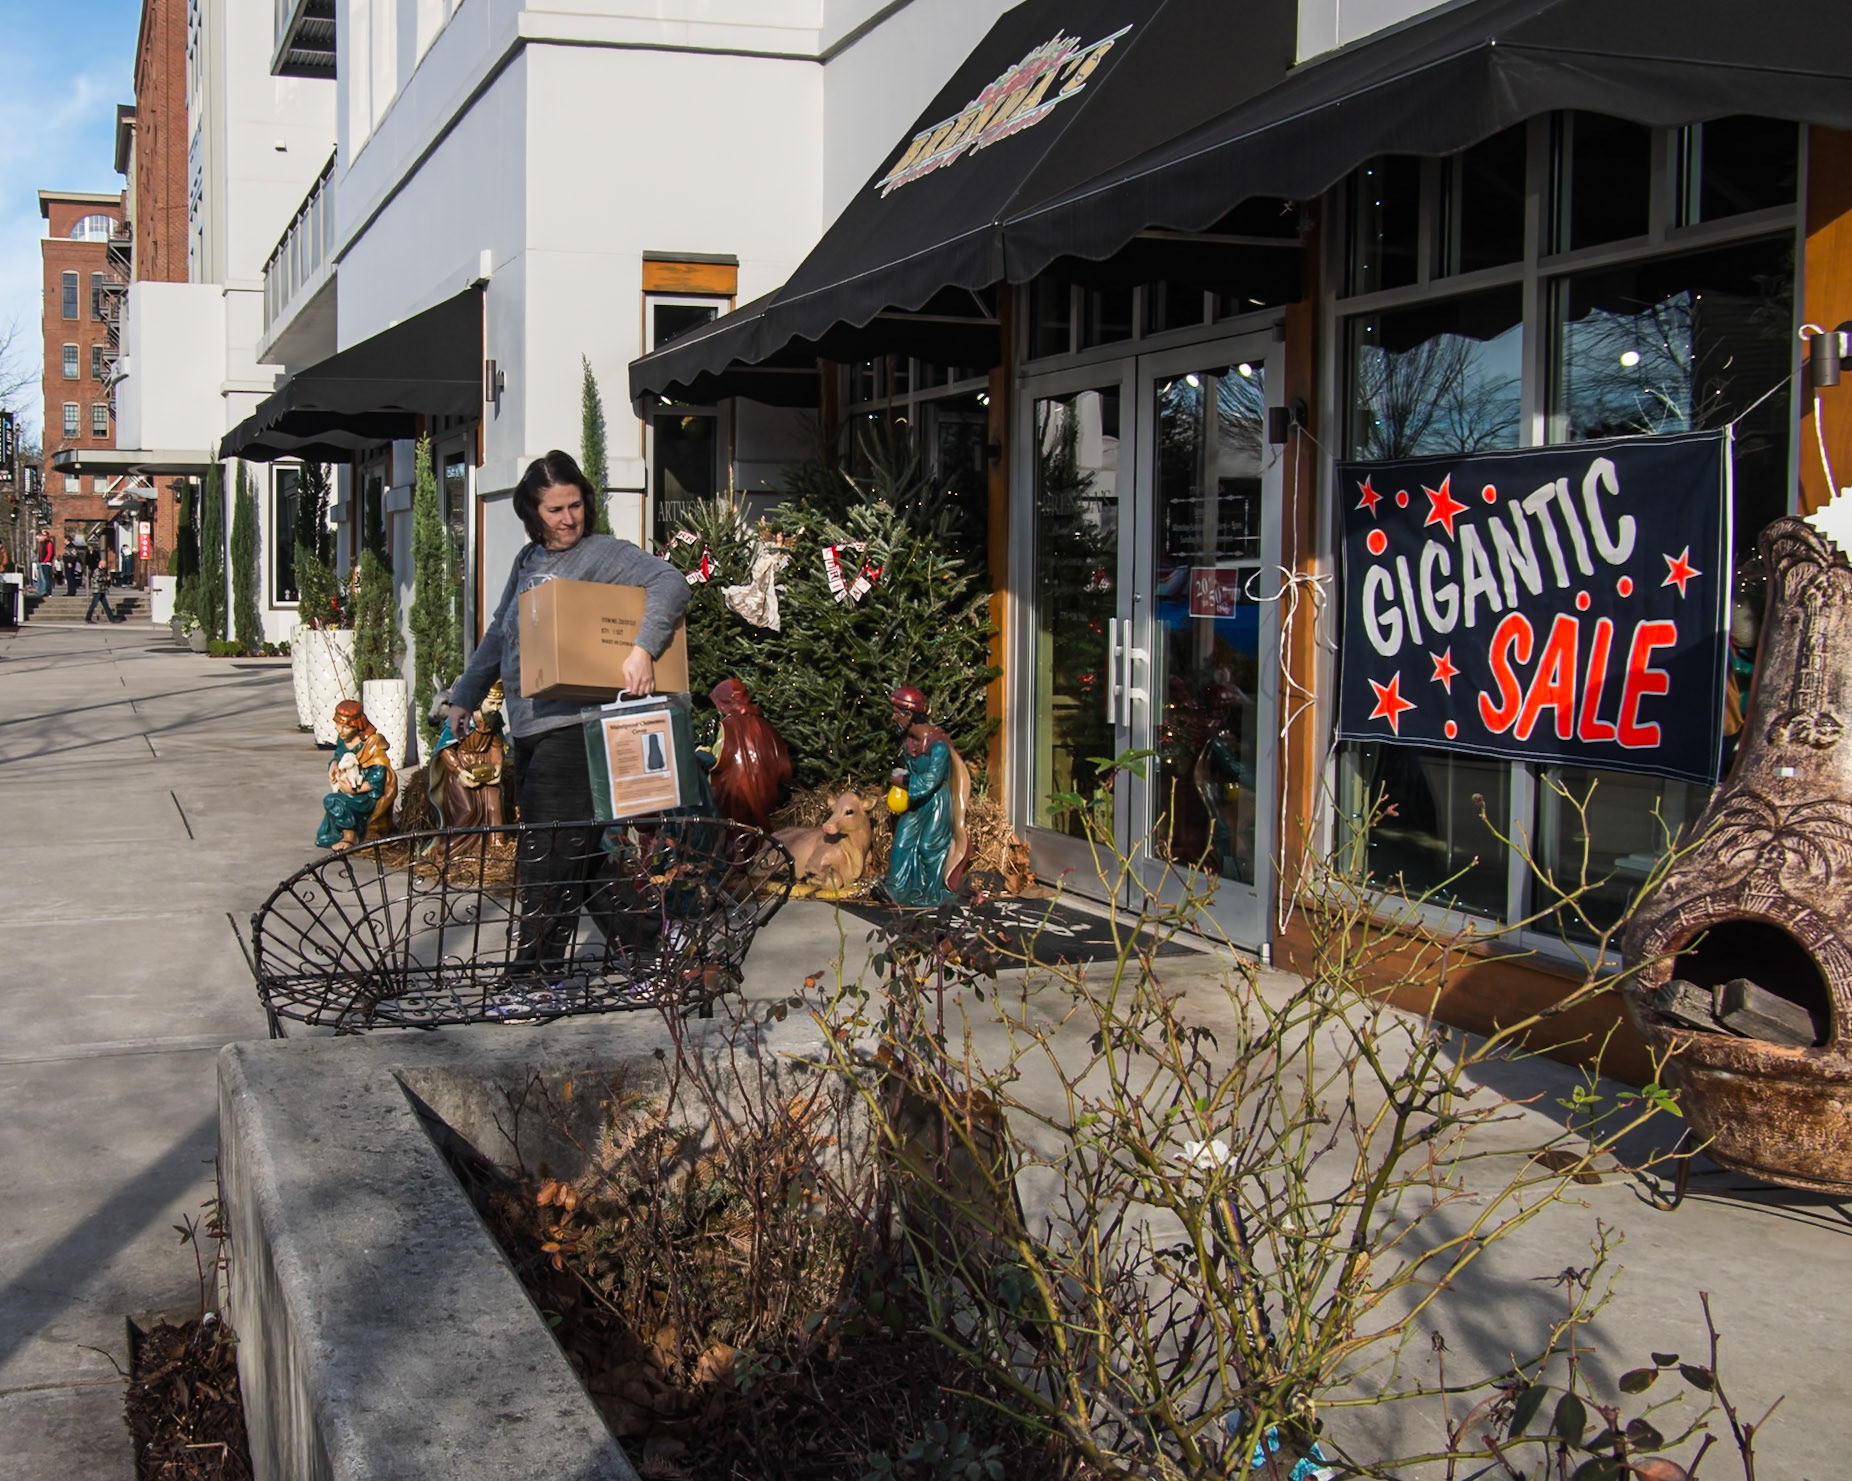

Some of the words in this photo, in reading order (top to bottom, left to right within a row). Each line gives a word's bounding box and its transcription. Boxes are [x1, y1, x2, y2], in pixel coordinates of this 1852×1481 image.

[886, 40, 1114, 180] BRENDA'S
[1362, 457, 1637, 657] GIGANTIC
[1478, 611, 1677, 748] SALE
